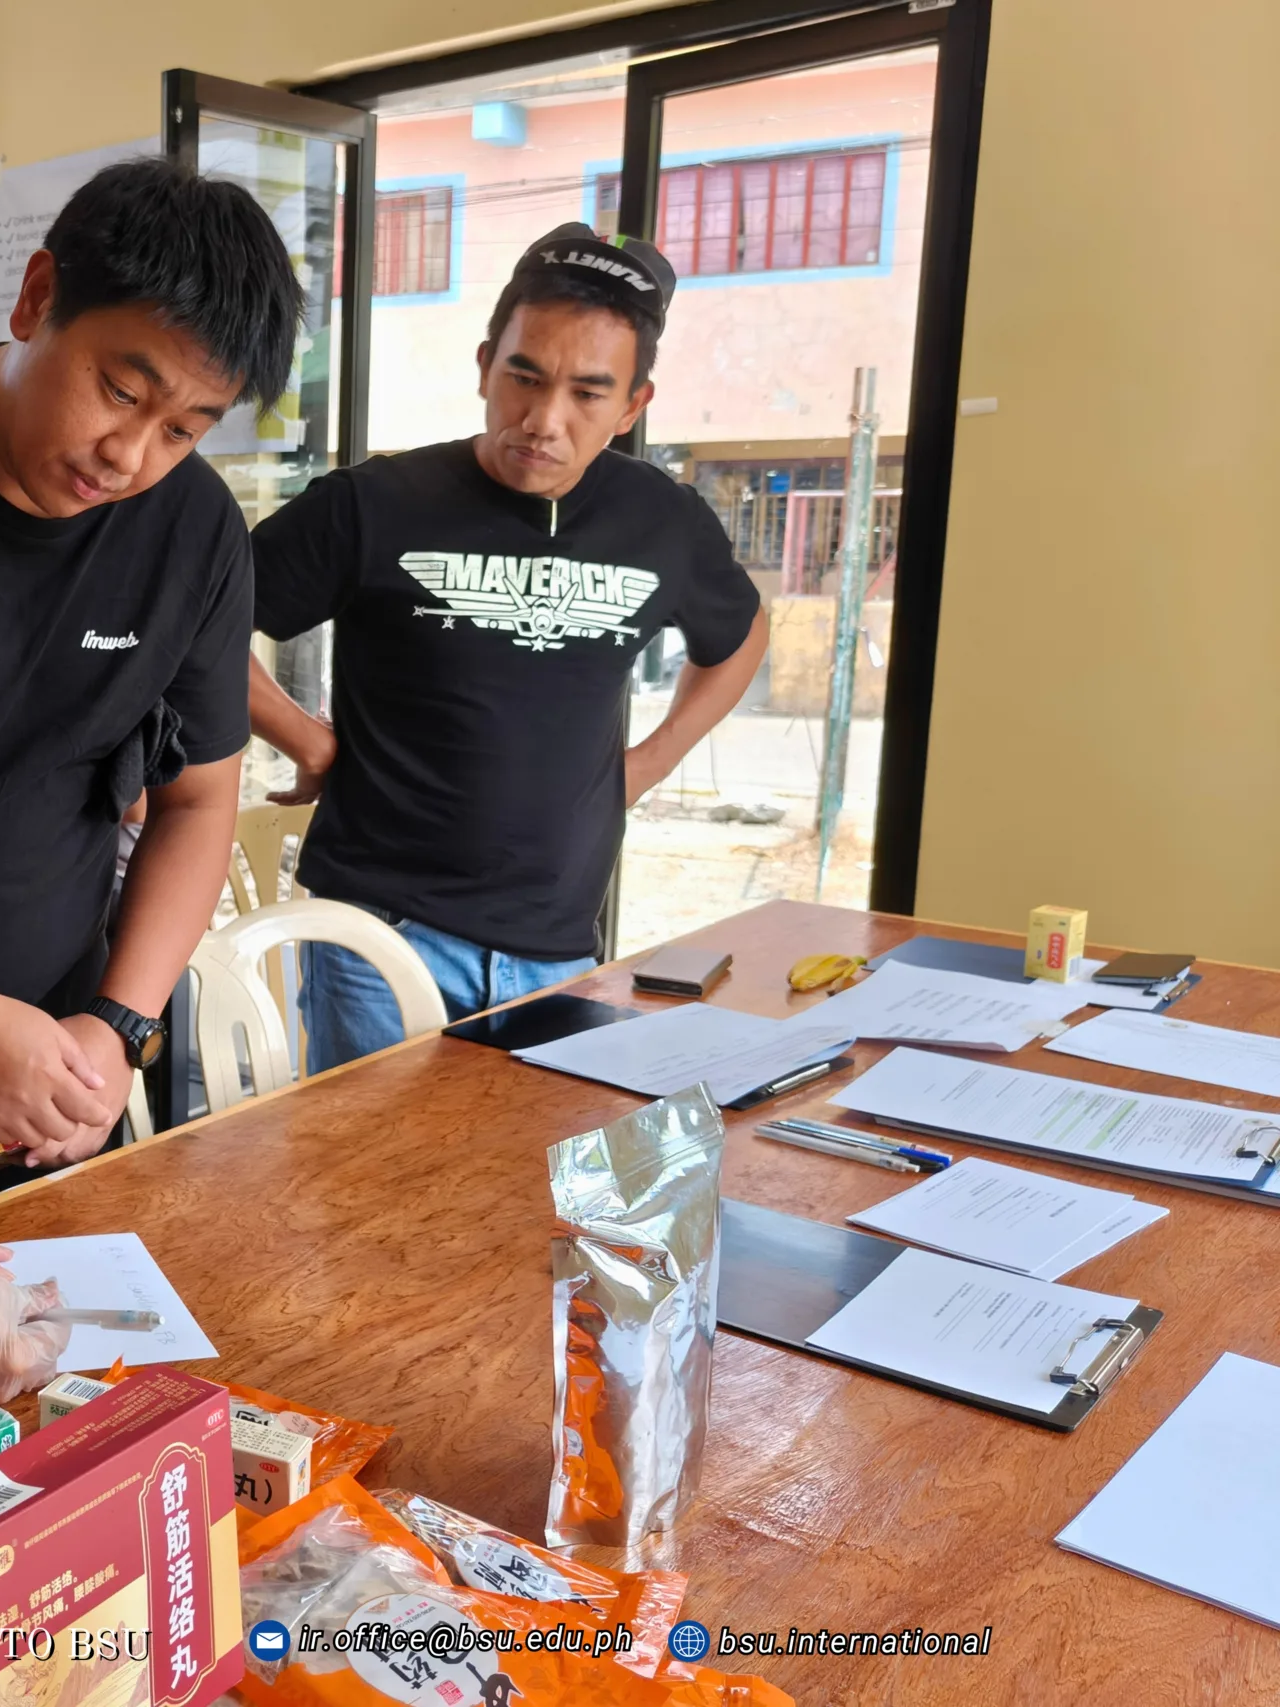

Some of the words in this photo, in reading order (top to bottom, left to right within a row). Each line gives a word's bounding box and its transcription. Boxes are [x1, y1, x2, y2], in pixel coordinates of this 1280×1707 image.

[539, 250, 560, 264] X
[563, 251, 656, 292] PLANET
[444, 553, 627, 606] MAVERICK
[207, 1409, 225, 1427] OTC
[160, 1463, 198, 1689] 舒筋活络丸
